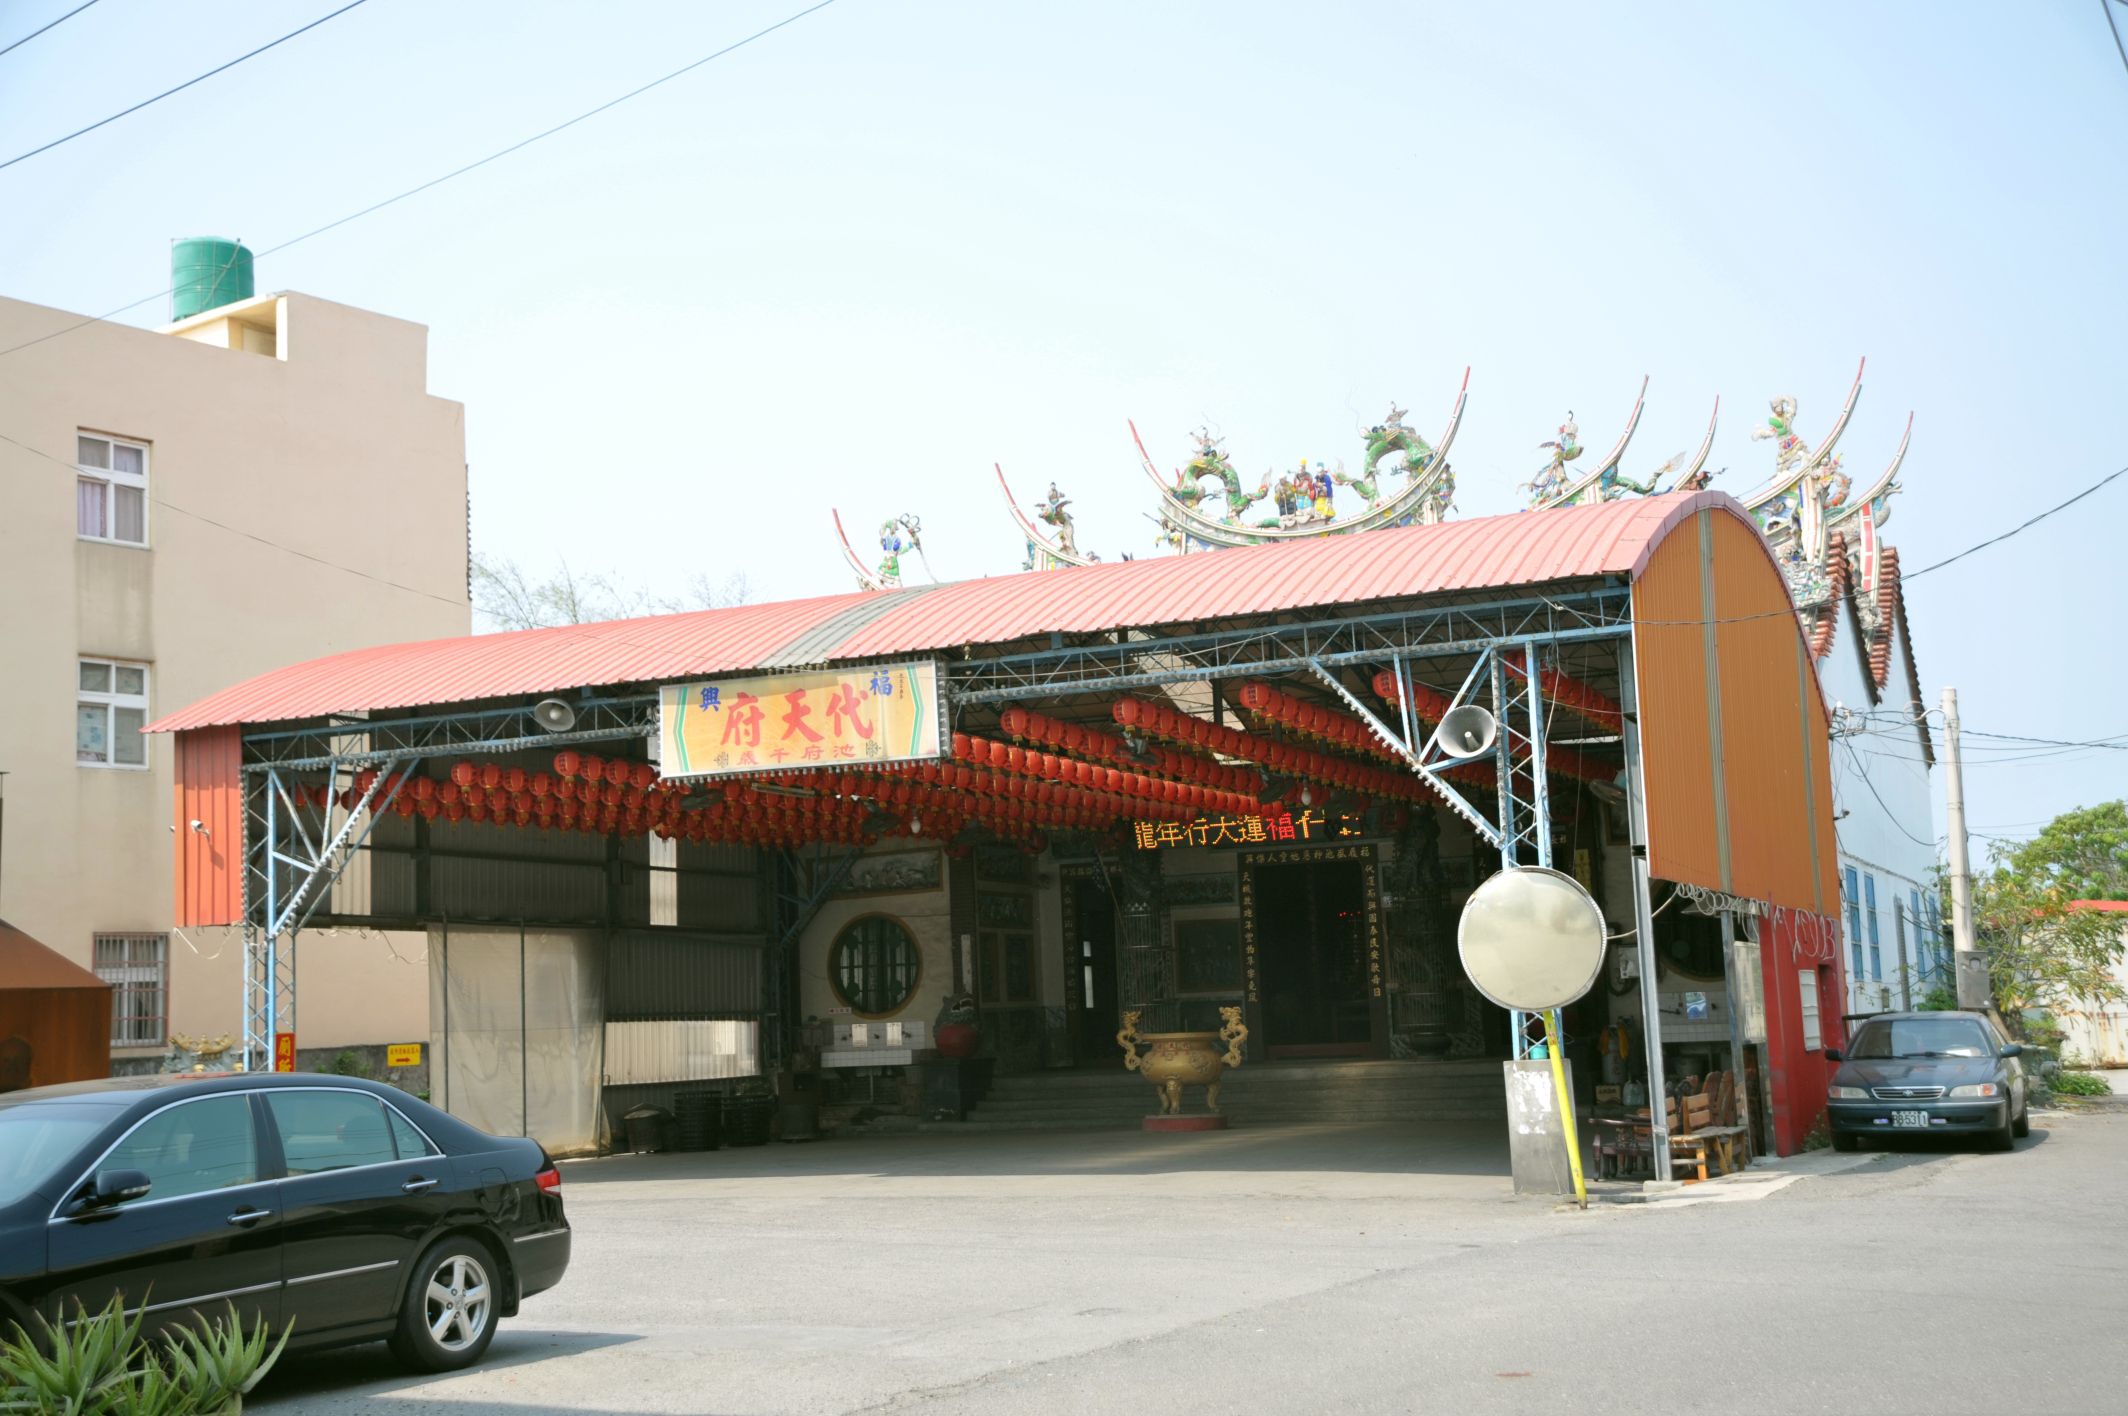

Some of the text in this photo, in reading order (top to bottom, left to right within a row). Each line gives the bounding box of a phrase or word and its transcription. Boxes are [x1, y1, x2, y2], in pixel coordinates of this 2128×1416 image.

[870, 669, 893, 697] 福
[699, 686, 721, 712] 興
[720, 683, 874, 747] 代天府
